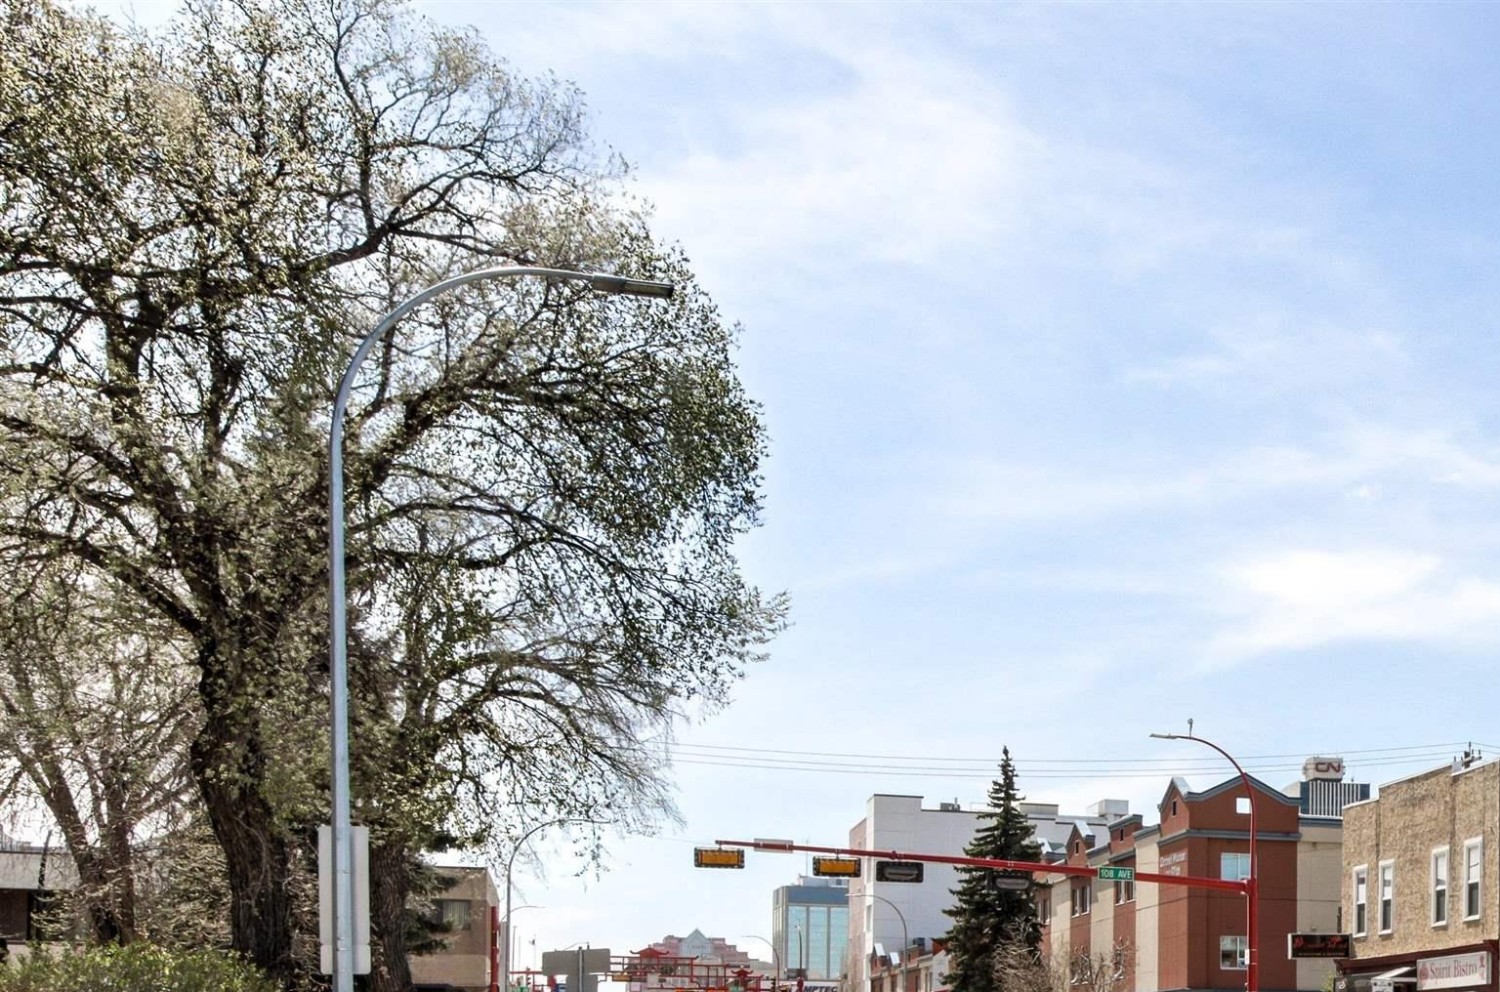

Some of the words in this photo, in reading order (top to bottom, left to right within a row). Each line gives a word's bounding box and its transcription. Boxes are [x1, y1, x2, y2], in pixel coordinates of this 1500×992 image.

[1315, 762, 1341, 773] CN
[1101, 869, 1114, 878] 108
[1118, 869, 1132, 879] AVE
[1430, 963, 1451, 983] Spirit
[1453, 960, 1477, 978] Bistro
